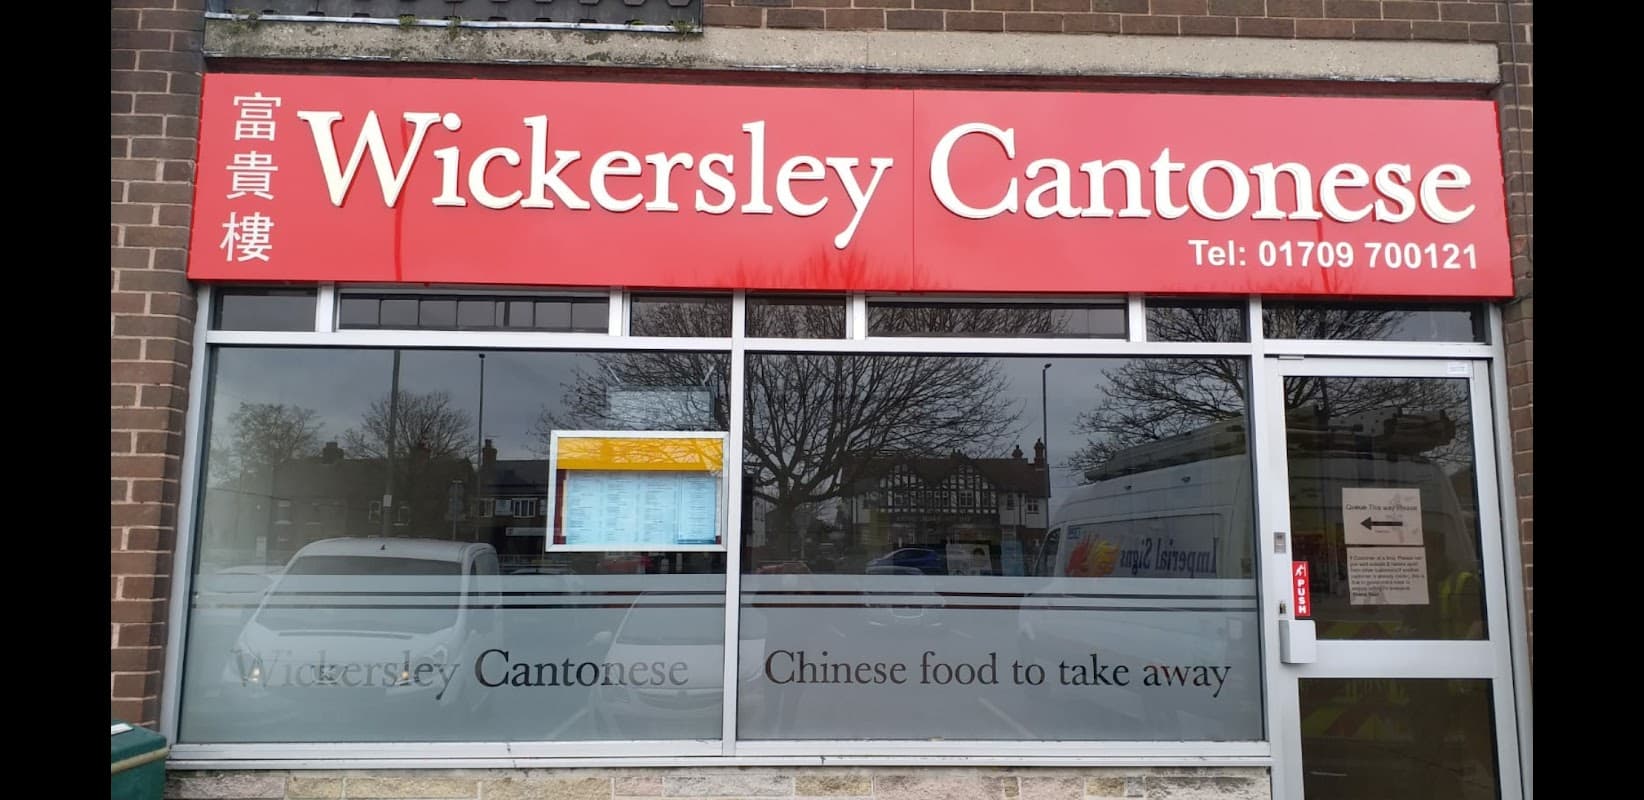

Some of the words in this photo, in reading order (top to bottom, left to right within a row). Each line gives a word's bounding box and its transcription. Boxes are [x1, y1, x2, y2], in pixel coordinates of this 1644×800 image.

[219, 91, 282, 263] 富貴樓
[297, 109, 894, 250] Wickersley
[929, 121, 1477, 225] Cantonese
[1188, 239, 1247, 267] Tel:
[1258, 240, 1355, 269] 01709
[1364, 241, 1479, 270] 700121
[1297, 578, 1307, 614] PUSH
[231, 649, 460, 700] Wickersley
[474, 648, 689, 687] Cantonese
[764, 649, 907, 685] Chinese
[920, 651, 999, 686] food
[1012, 659, 1045, 686] to
[1059, 653, 1130, 687] take
[1143, 661, 1232, 698] away
